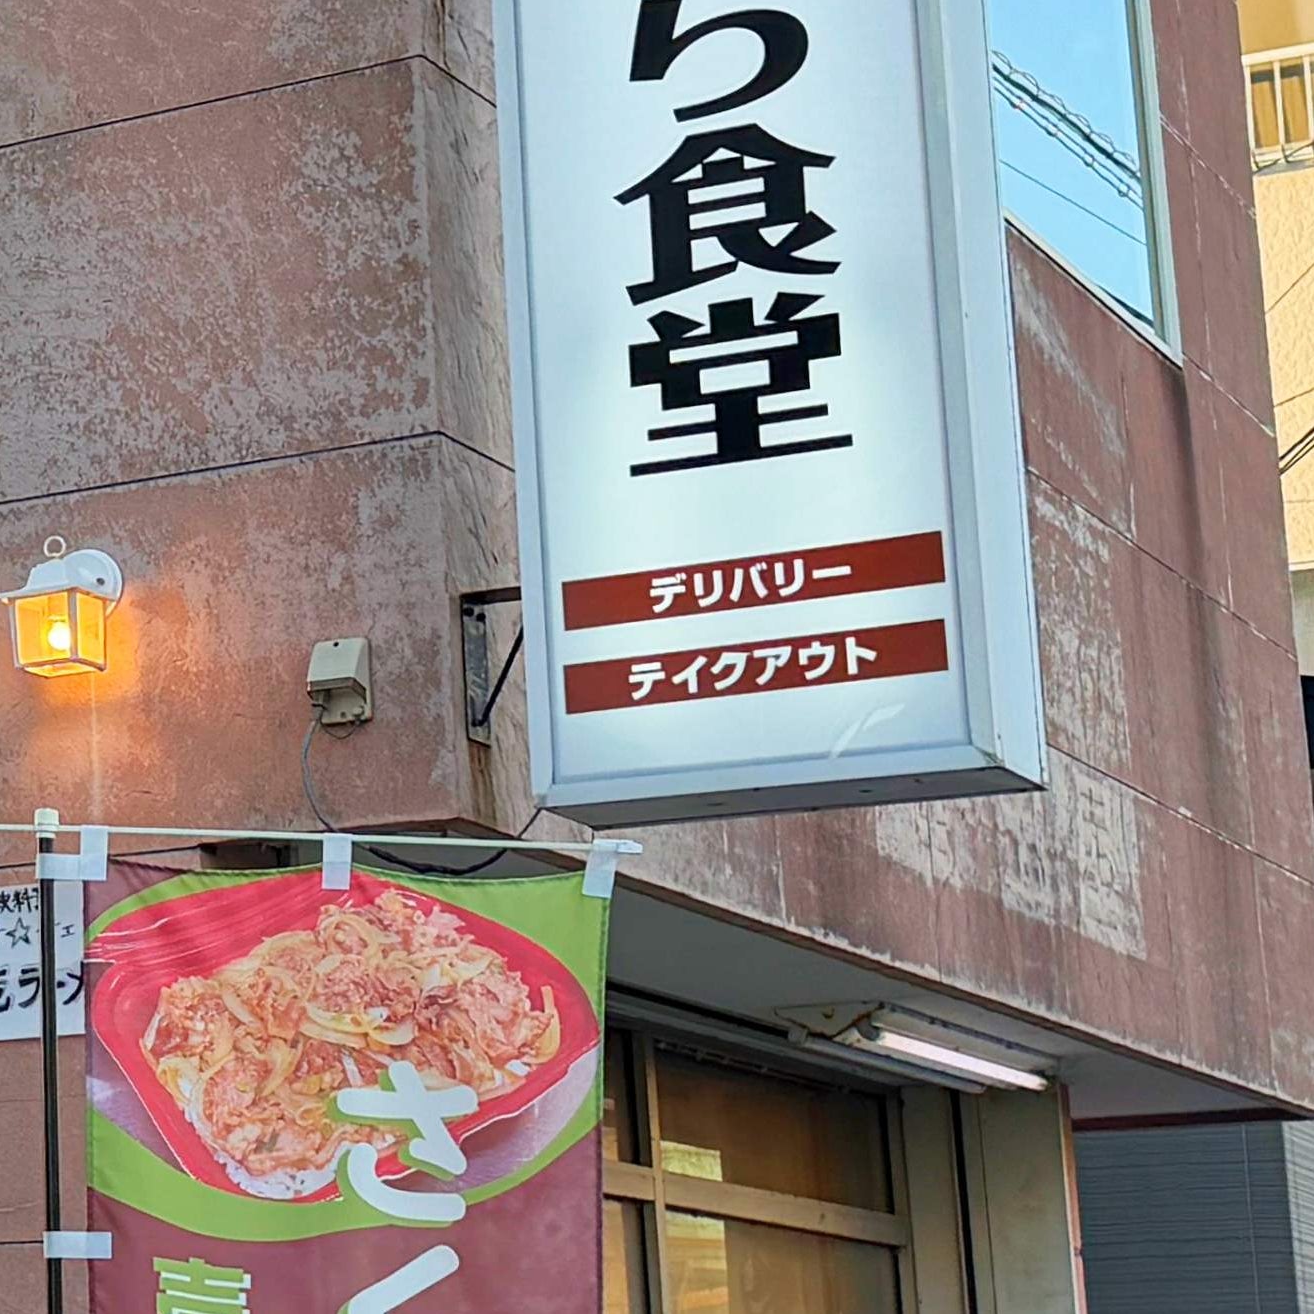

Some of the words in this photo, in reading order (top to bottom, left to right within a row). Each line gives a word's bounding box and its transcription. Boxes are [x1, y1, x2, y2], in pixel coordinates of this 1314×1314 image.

[649, 558, 852, 614] デリバリー
[628, 636, 878, 701] テイクアウト
